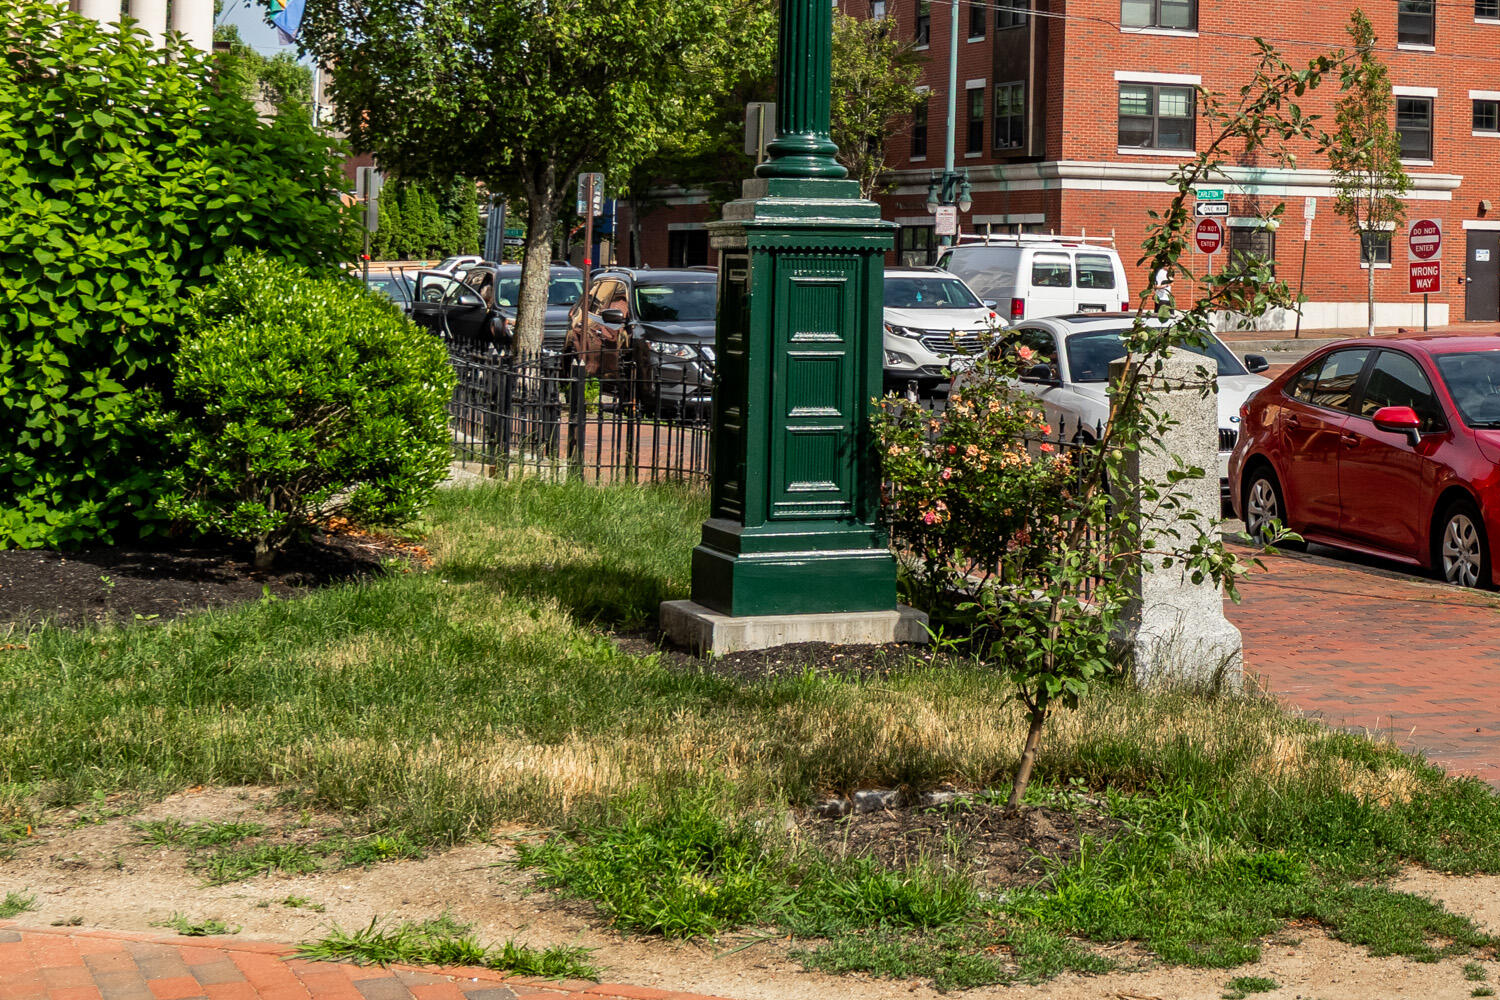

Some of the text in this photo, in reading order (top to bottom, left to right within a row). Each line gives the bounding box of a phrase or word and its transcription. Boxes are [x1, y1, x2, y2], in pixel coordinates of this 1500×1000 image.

[1416, 244, 1433, 252] ENTER
[1411, 266, 1438, 277] WRONG
[1416, 279, 1433, 288] WAY
